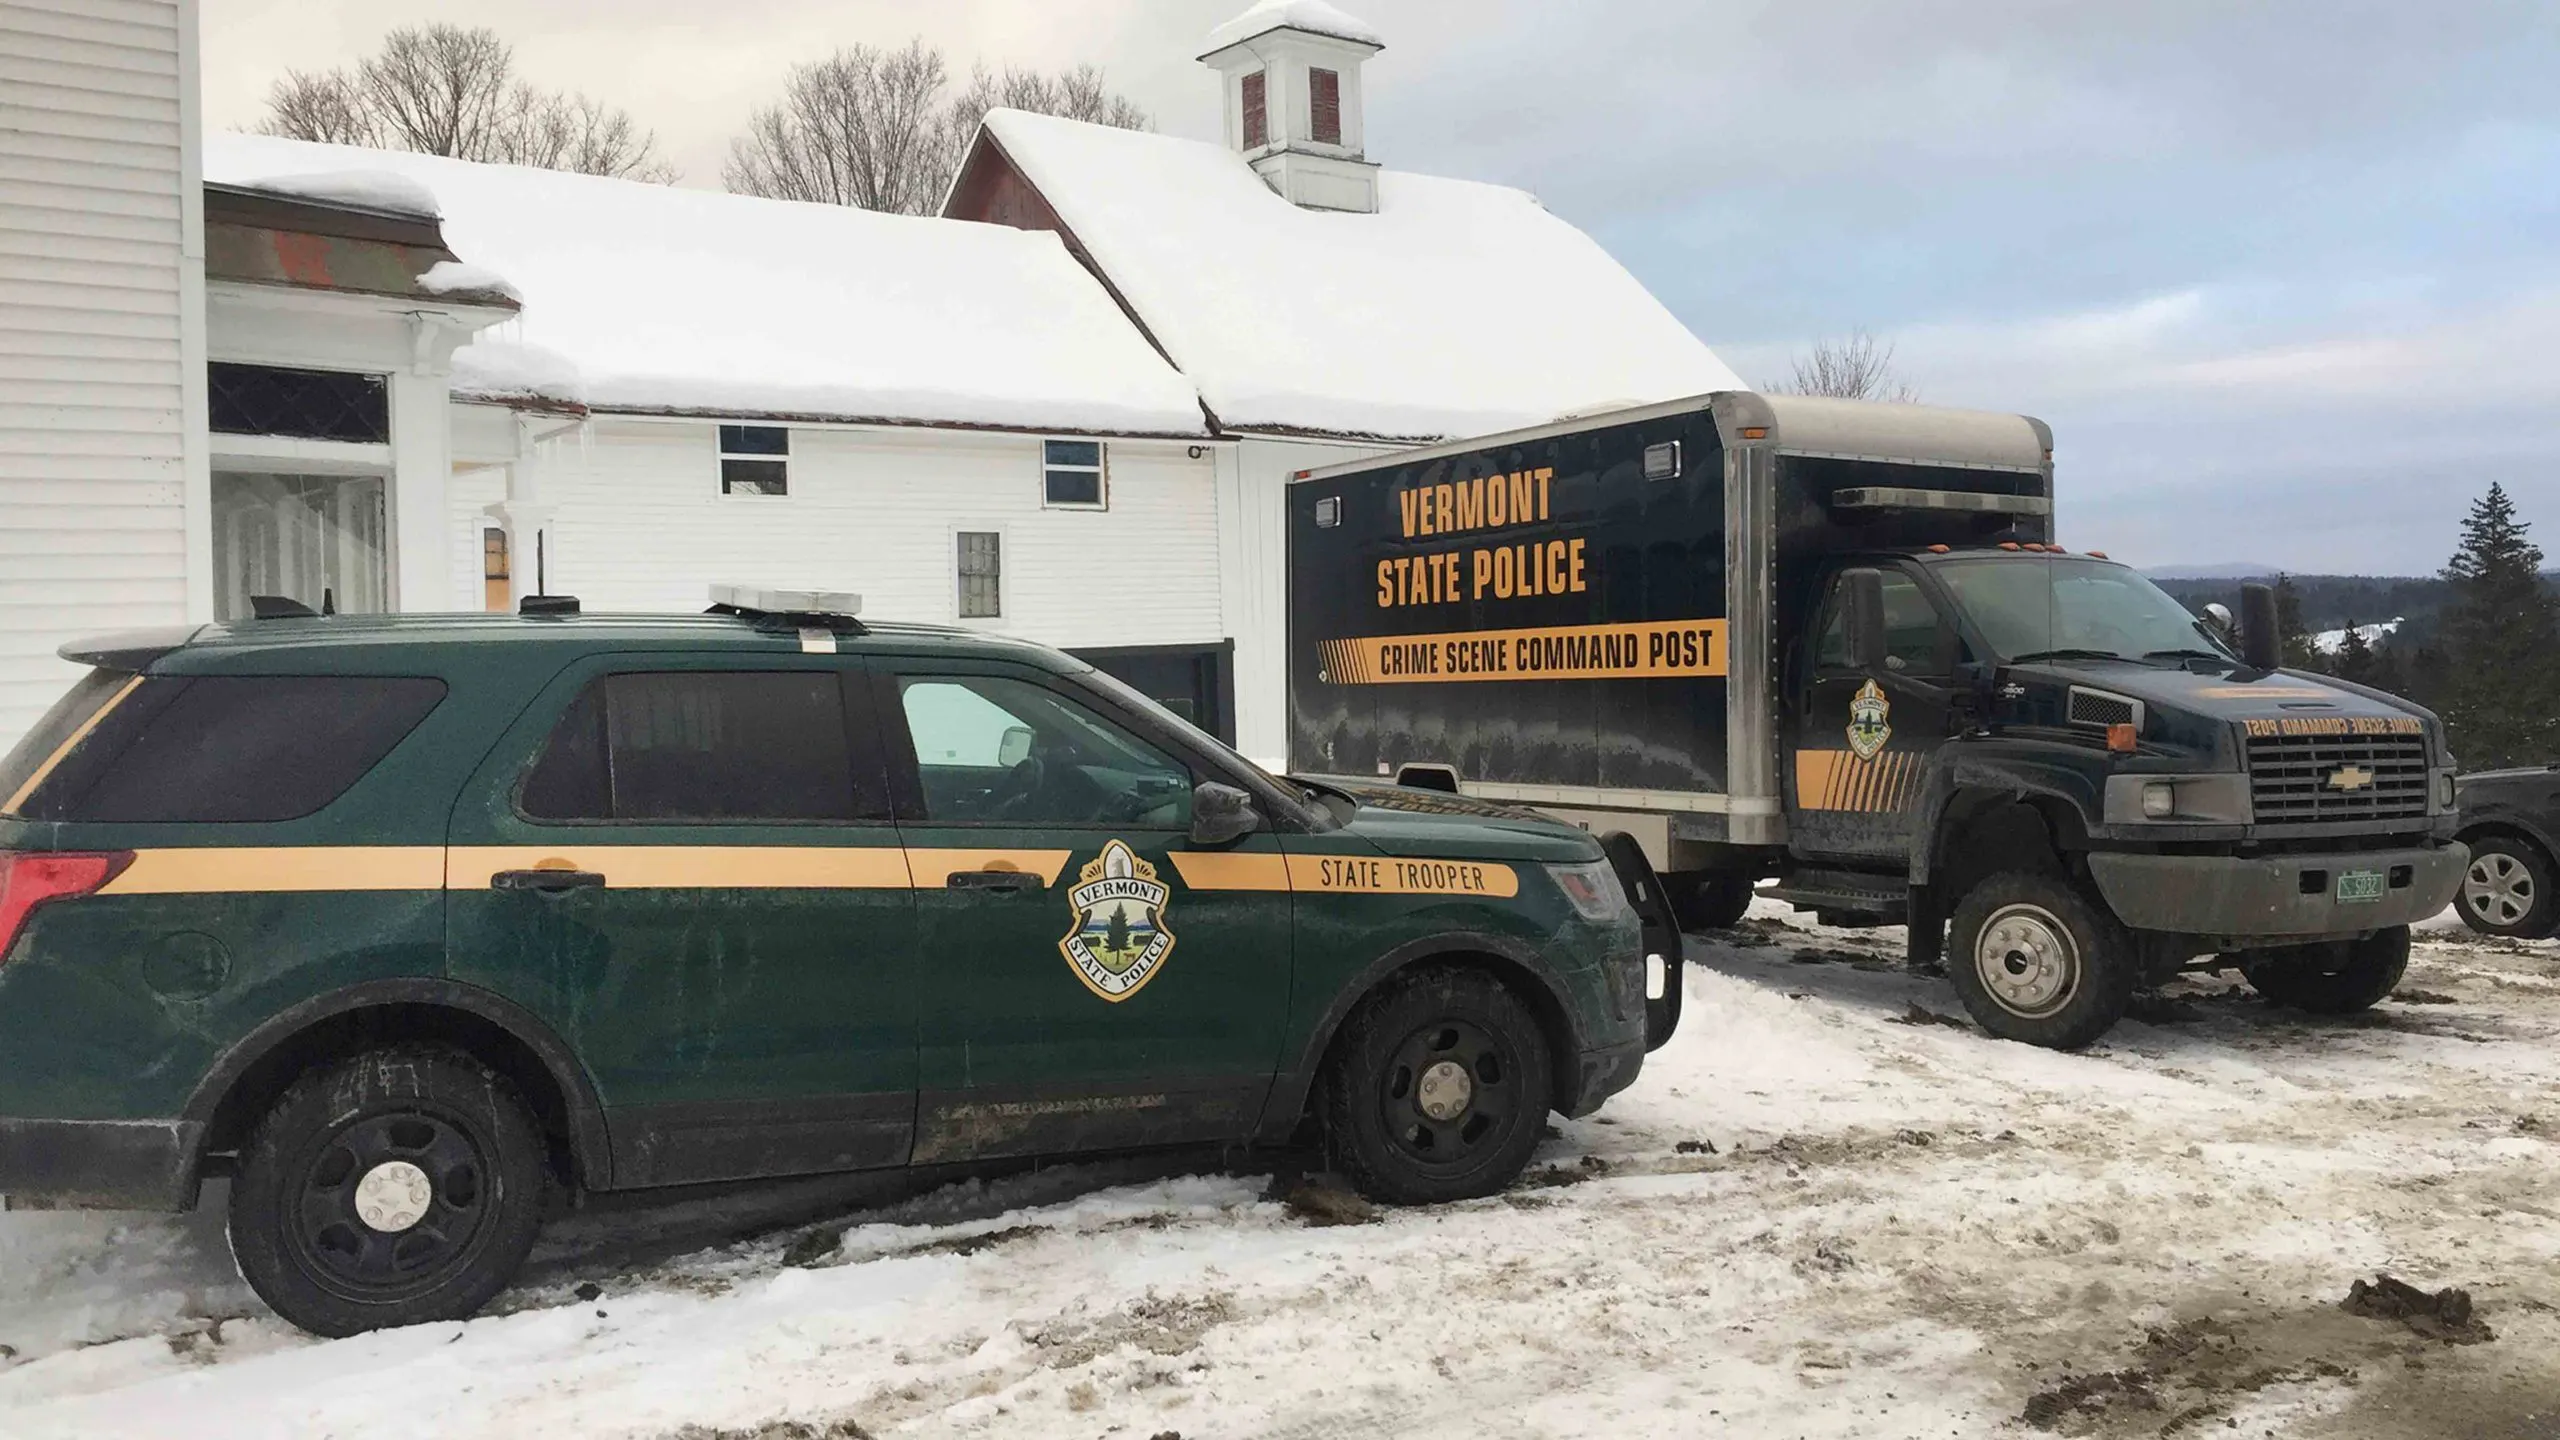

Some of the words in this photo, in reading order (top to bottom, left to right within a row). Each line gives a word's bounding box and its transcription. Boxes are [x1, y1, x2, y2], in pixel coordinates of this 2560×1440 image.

[1400, 467, 1553, 538] VERMONT
[1377, 553, 1460, 608] STATE
[1473, 538, 1587, 600] POLICE
[1380, 643, 1439, 676] CRIME
[1446, 640, 1507, 674] SCENE
[1516, 633, 1639, 671] COMMAND
[1649, 630, 1714, 668] POST
[1080, 881, 1162, 902] VERMONT
[1320, 859, 1381, 888] STATE
[1397, 862, 1486, 891] TROOPER
[1070, 939, 1112, 987] STATE
[1120, 935, 1167, 988] POLICE
